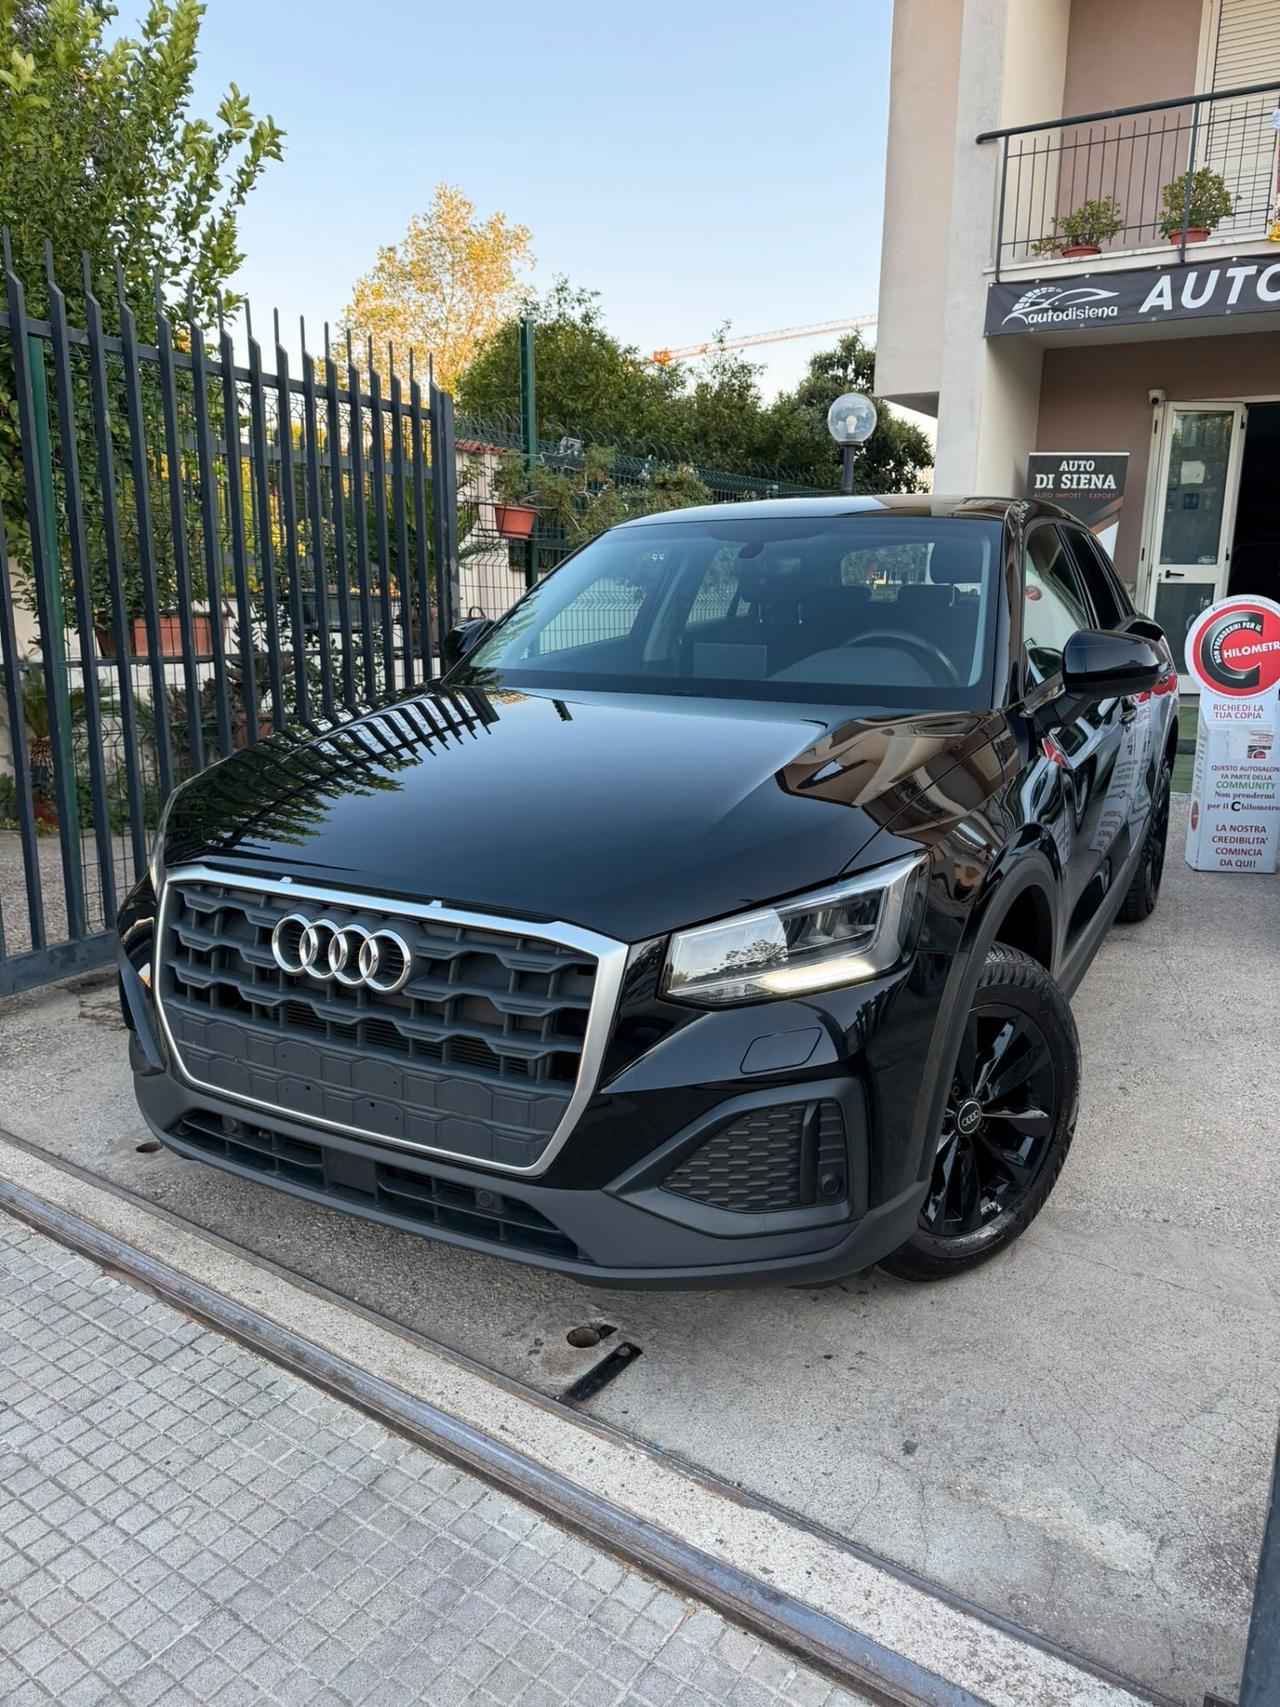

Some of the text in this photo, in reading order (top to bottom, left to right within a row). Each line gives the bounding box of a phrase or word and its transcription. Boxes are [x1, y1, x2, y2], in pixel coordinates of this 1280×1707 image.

[1138, 263, 1280, 313] AUTO
[1028, 305, 1118, 325] autodisiena
[1059, 460, 1095, 471] AUTO
[1034, 474, 1117, 489] DI SIENA
[1223, 640, 1280, 659] HILOMETR
[1213, 703, 1264, 712] RICHIEDI LA
[1214, 711, 1262, 719] TUA COPIA
[1211, 764, 1239, 772] QUESTO
[1216, 781, 1276, 790] COMMUNITY
[1214, 790, 1275, 800] Non prendermi
[1207, 803, 1222, 811] per
[1216, 824, 1267, 833] LA NOSTRA
[1212, 835, 1269, 845] CREDIBILITA'
[1215, 847, 1263, 857] COMINCIA
[1219, 859, 1256, 868] DA QUI!
